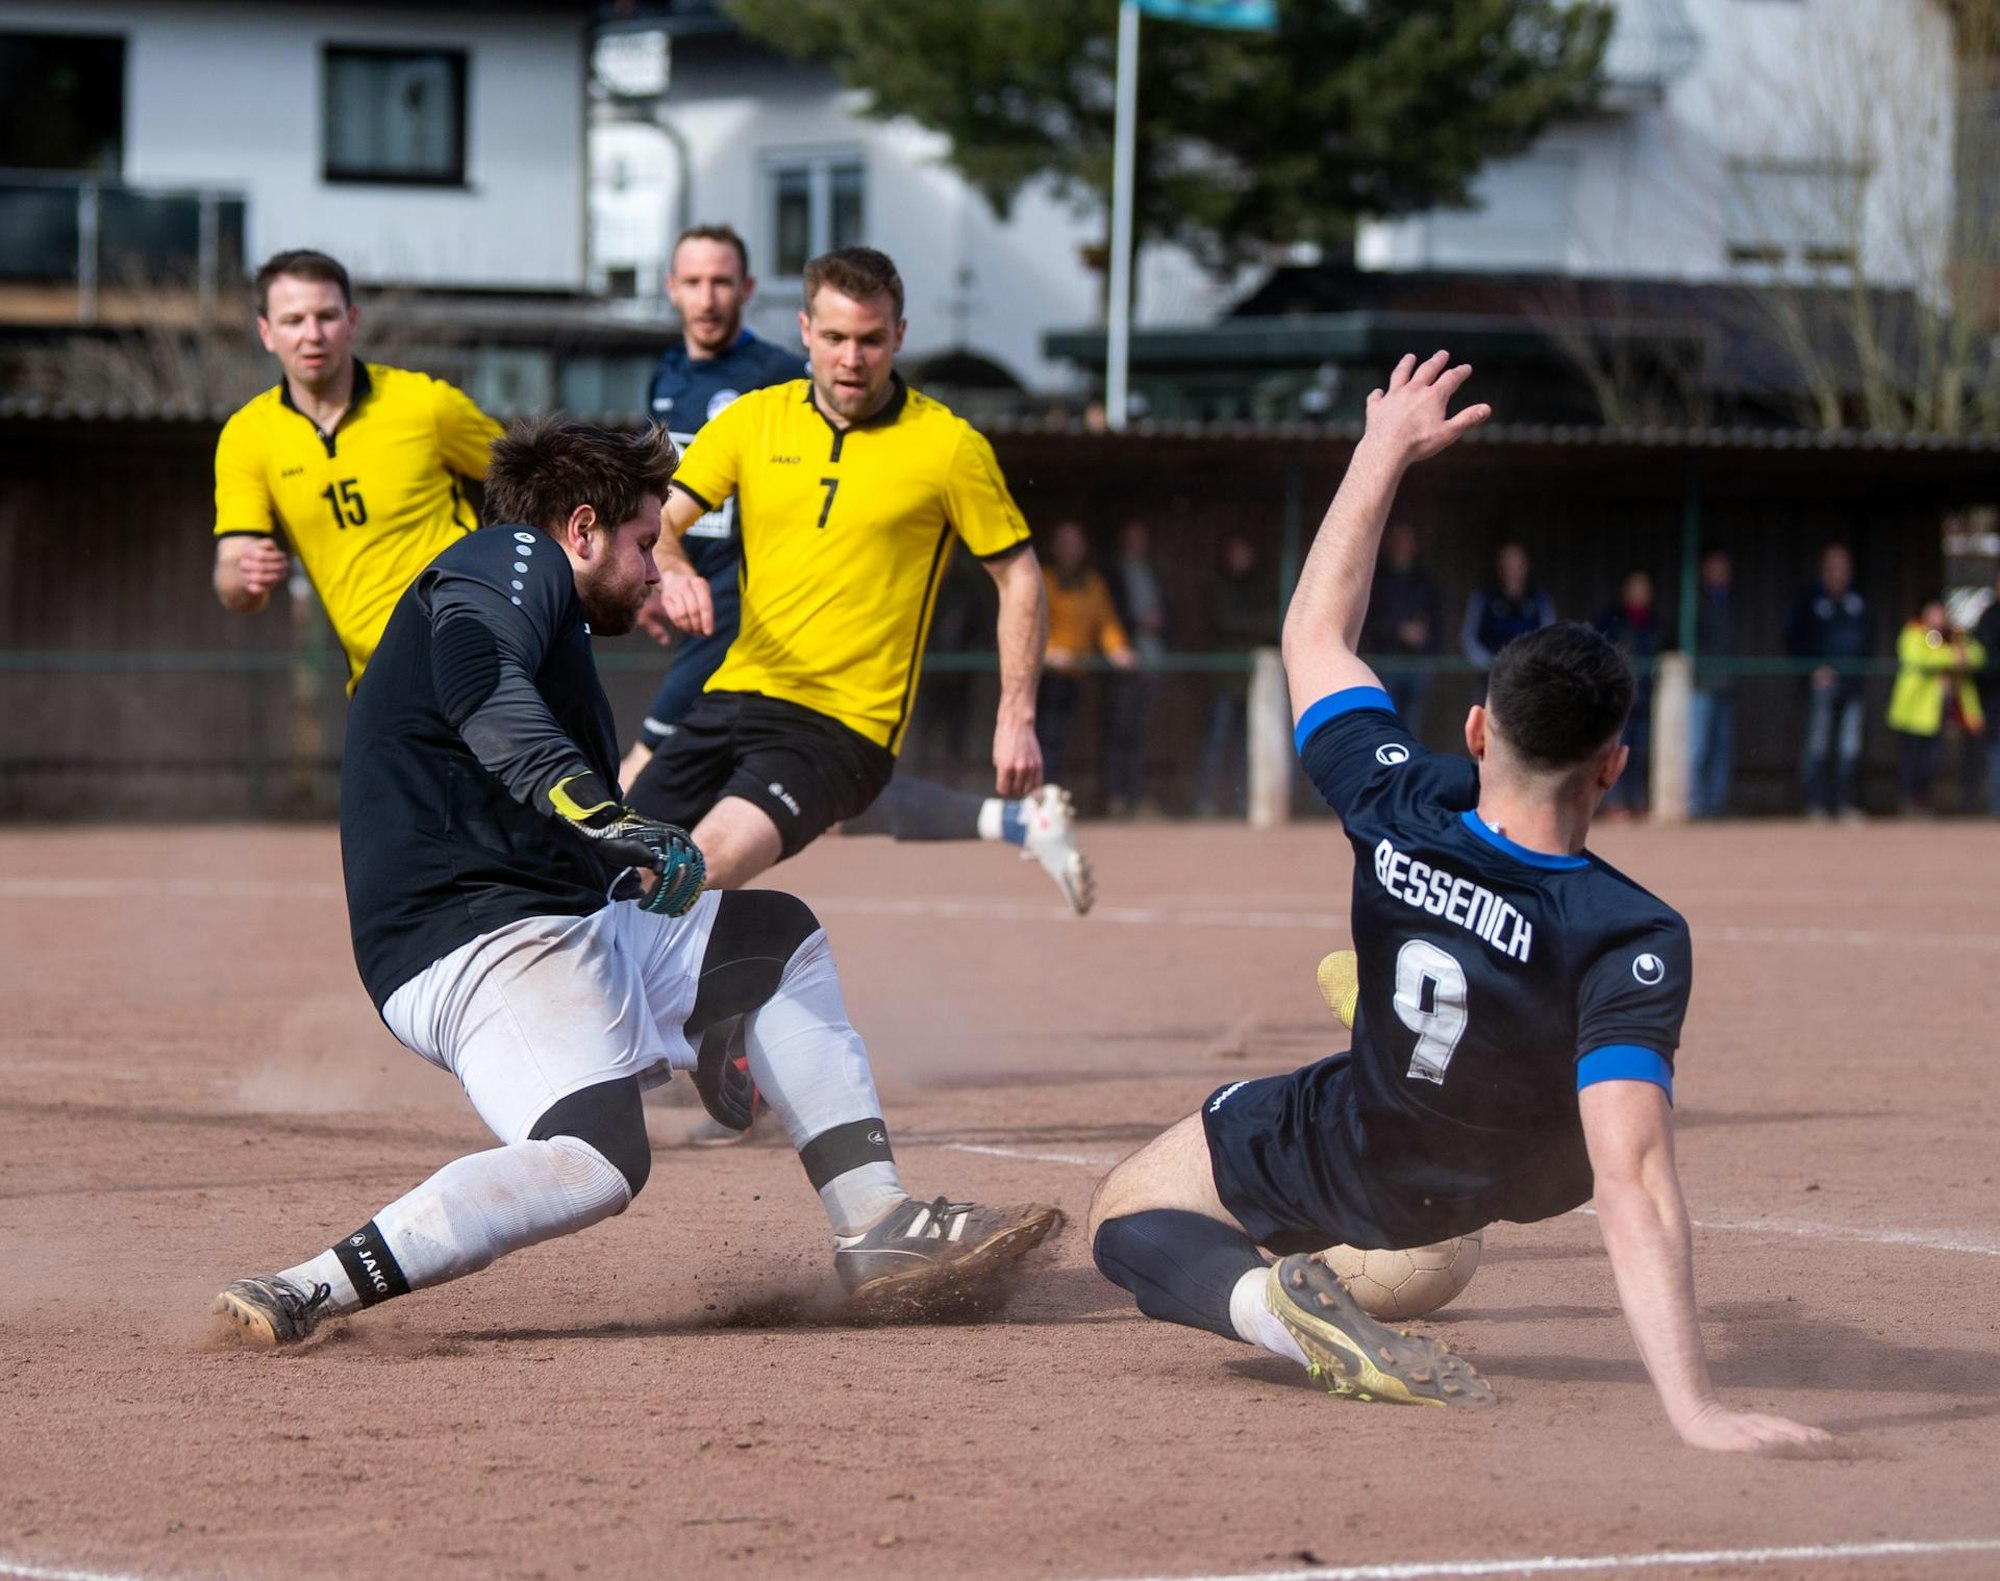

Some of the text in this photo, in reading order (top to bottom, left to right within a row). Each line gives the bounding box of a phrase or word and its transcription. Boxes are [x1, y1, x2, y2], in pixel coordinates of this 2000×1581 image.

[321, 478, 368, 530] 15
[817, 477, 839, 529] 7
[1374, 838, 1533, 963] BESSENICH
[1393, 938, 1468, 1086] 9
[358, 1250, 389, 1293] JAKO
